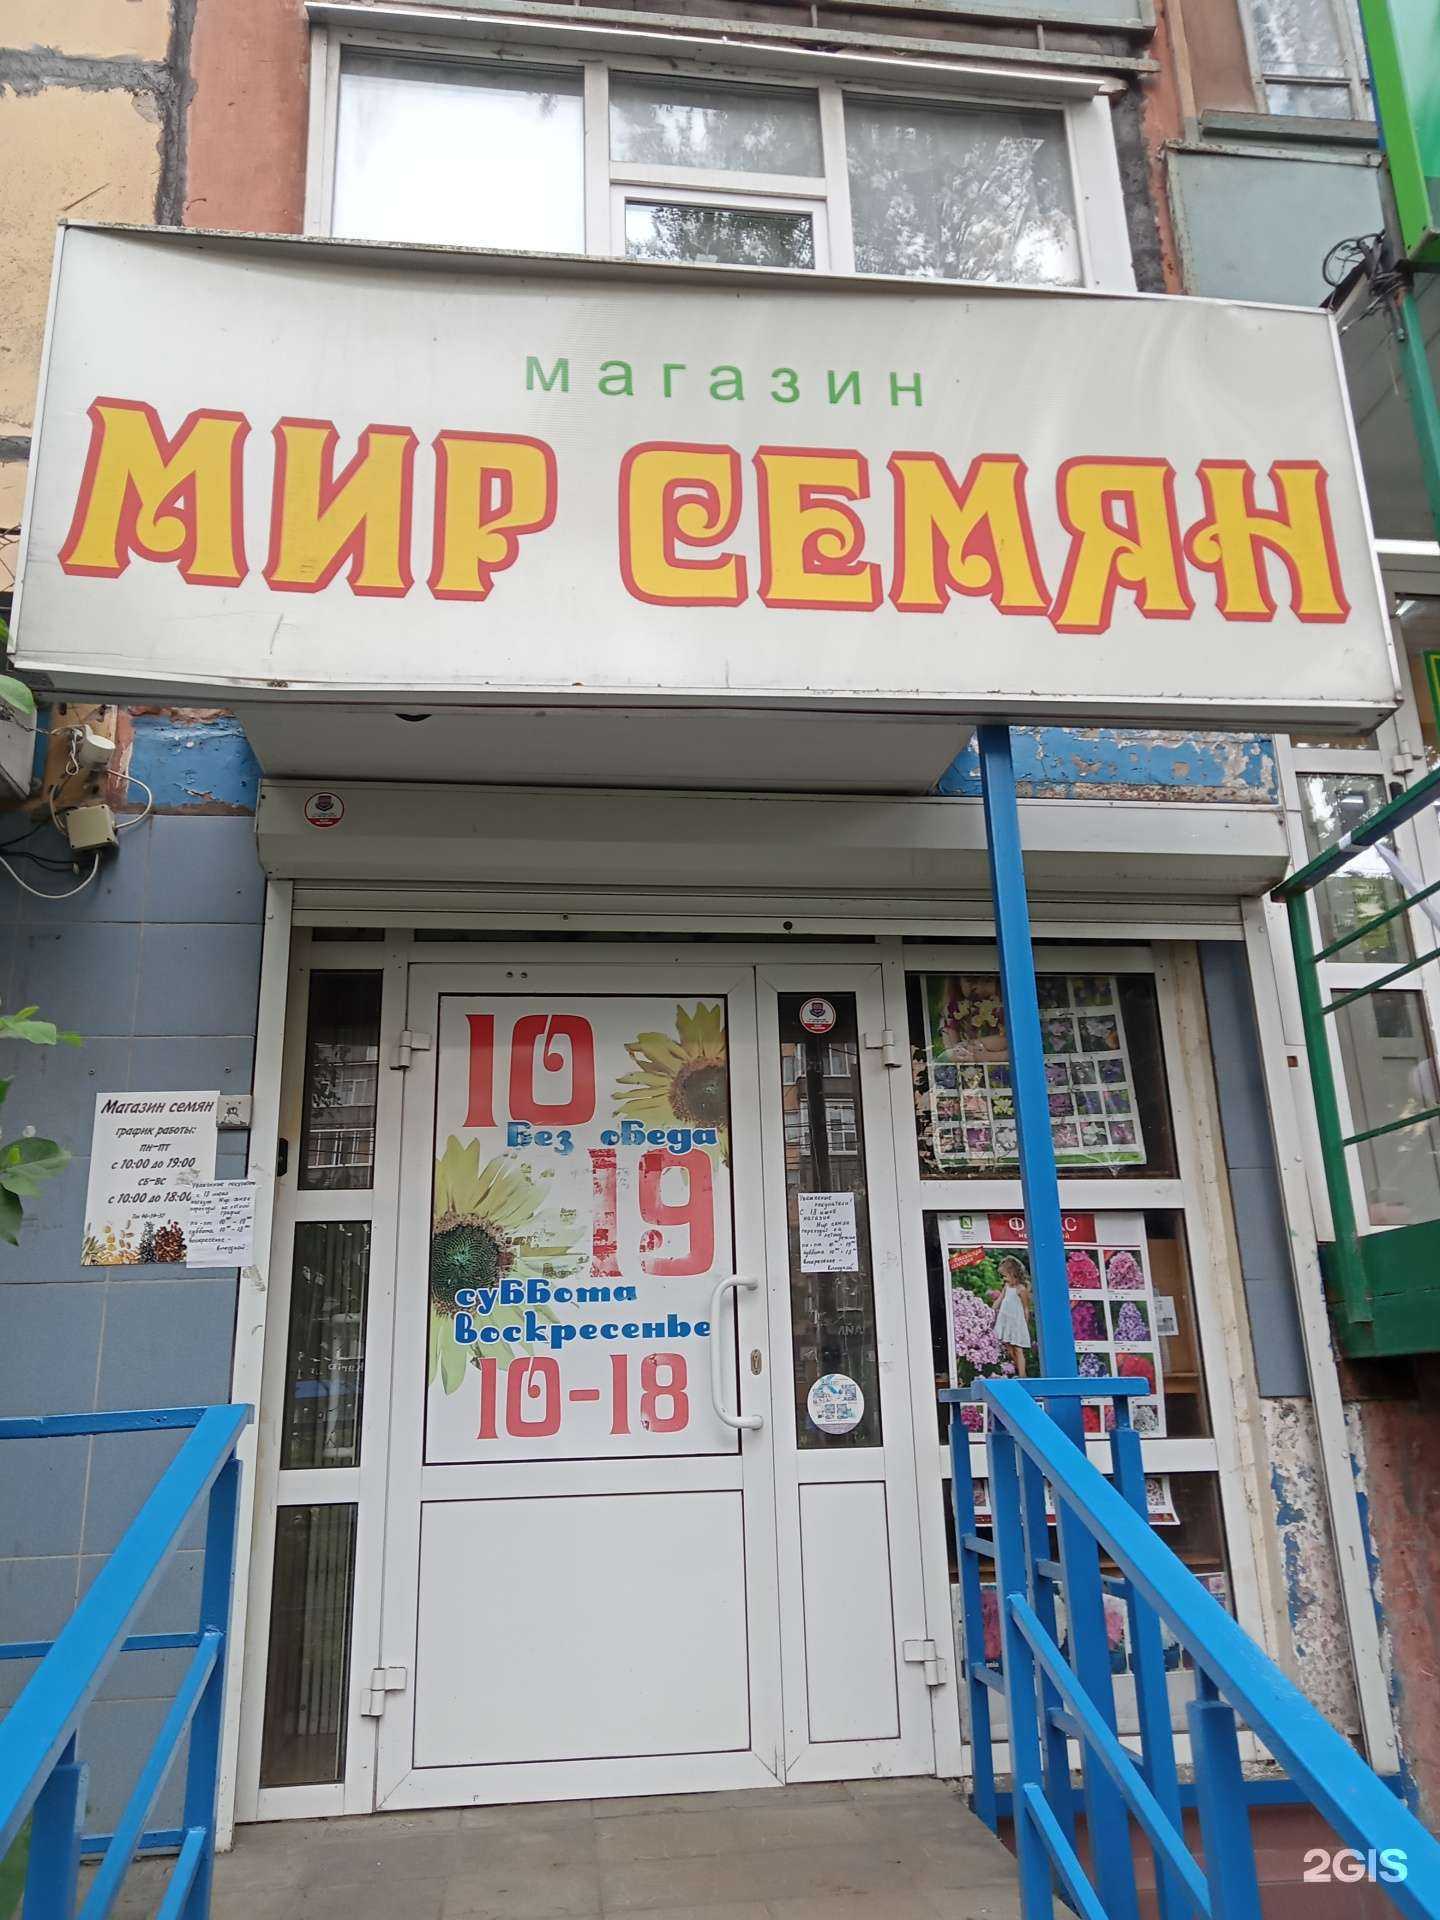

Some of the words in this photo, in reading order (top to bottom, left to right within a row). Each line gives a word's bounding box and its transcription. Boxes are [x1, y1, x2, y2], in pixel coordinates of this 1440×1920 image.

[526, 355, 923, 407] магазин
[58, 396, 558, 602] МИР
[619, 440, 1351, 636] СЕМЯН
[462, 1013, 596, 1128] 10
[101, 1099, 166, 1114] Магазин
[168, 1101, 214, 1113] семян
[115, 1127, 154, 1138] график
[599, 1120, 718, 1154] обеда
[119, 1158, 150, 1170] 10:00
[150, 1161, 164, 1169] до
[166, 1157, 196, 1168] 19:00
[116, 1192, 148, 1204] 10:00
[147, 1195, 162, 1203] до
[587, 1147, 715, 1278] 19
[455, 1279, 638, 1316] суббота
